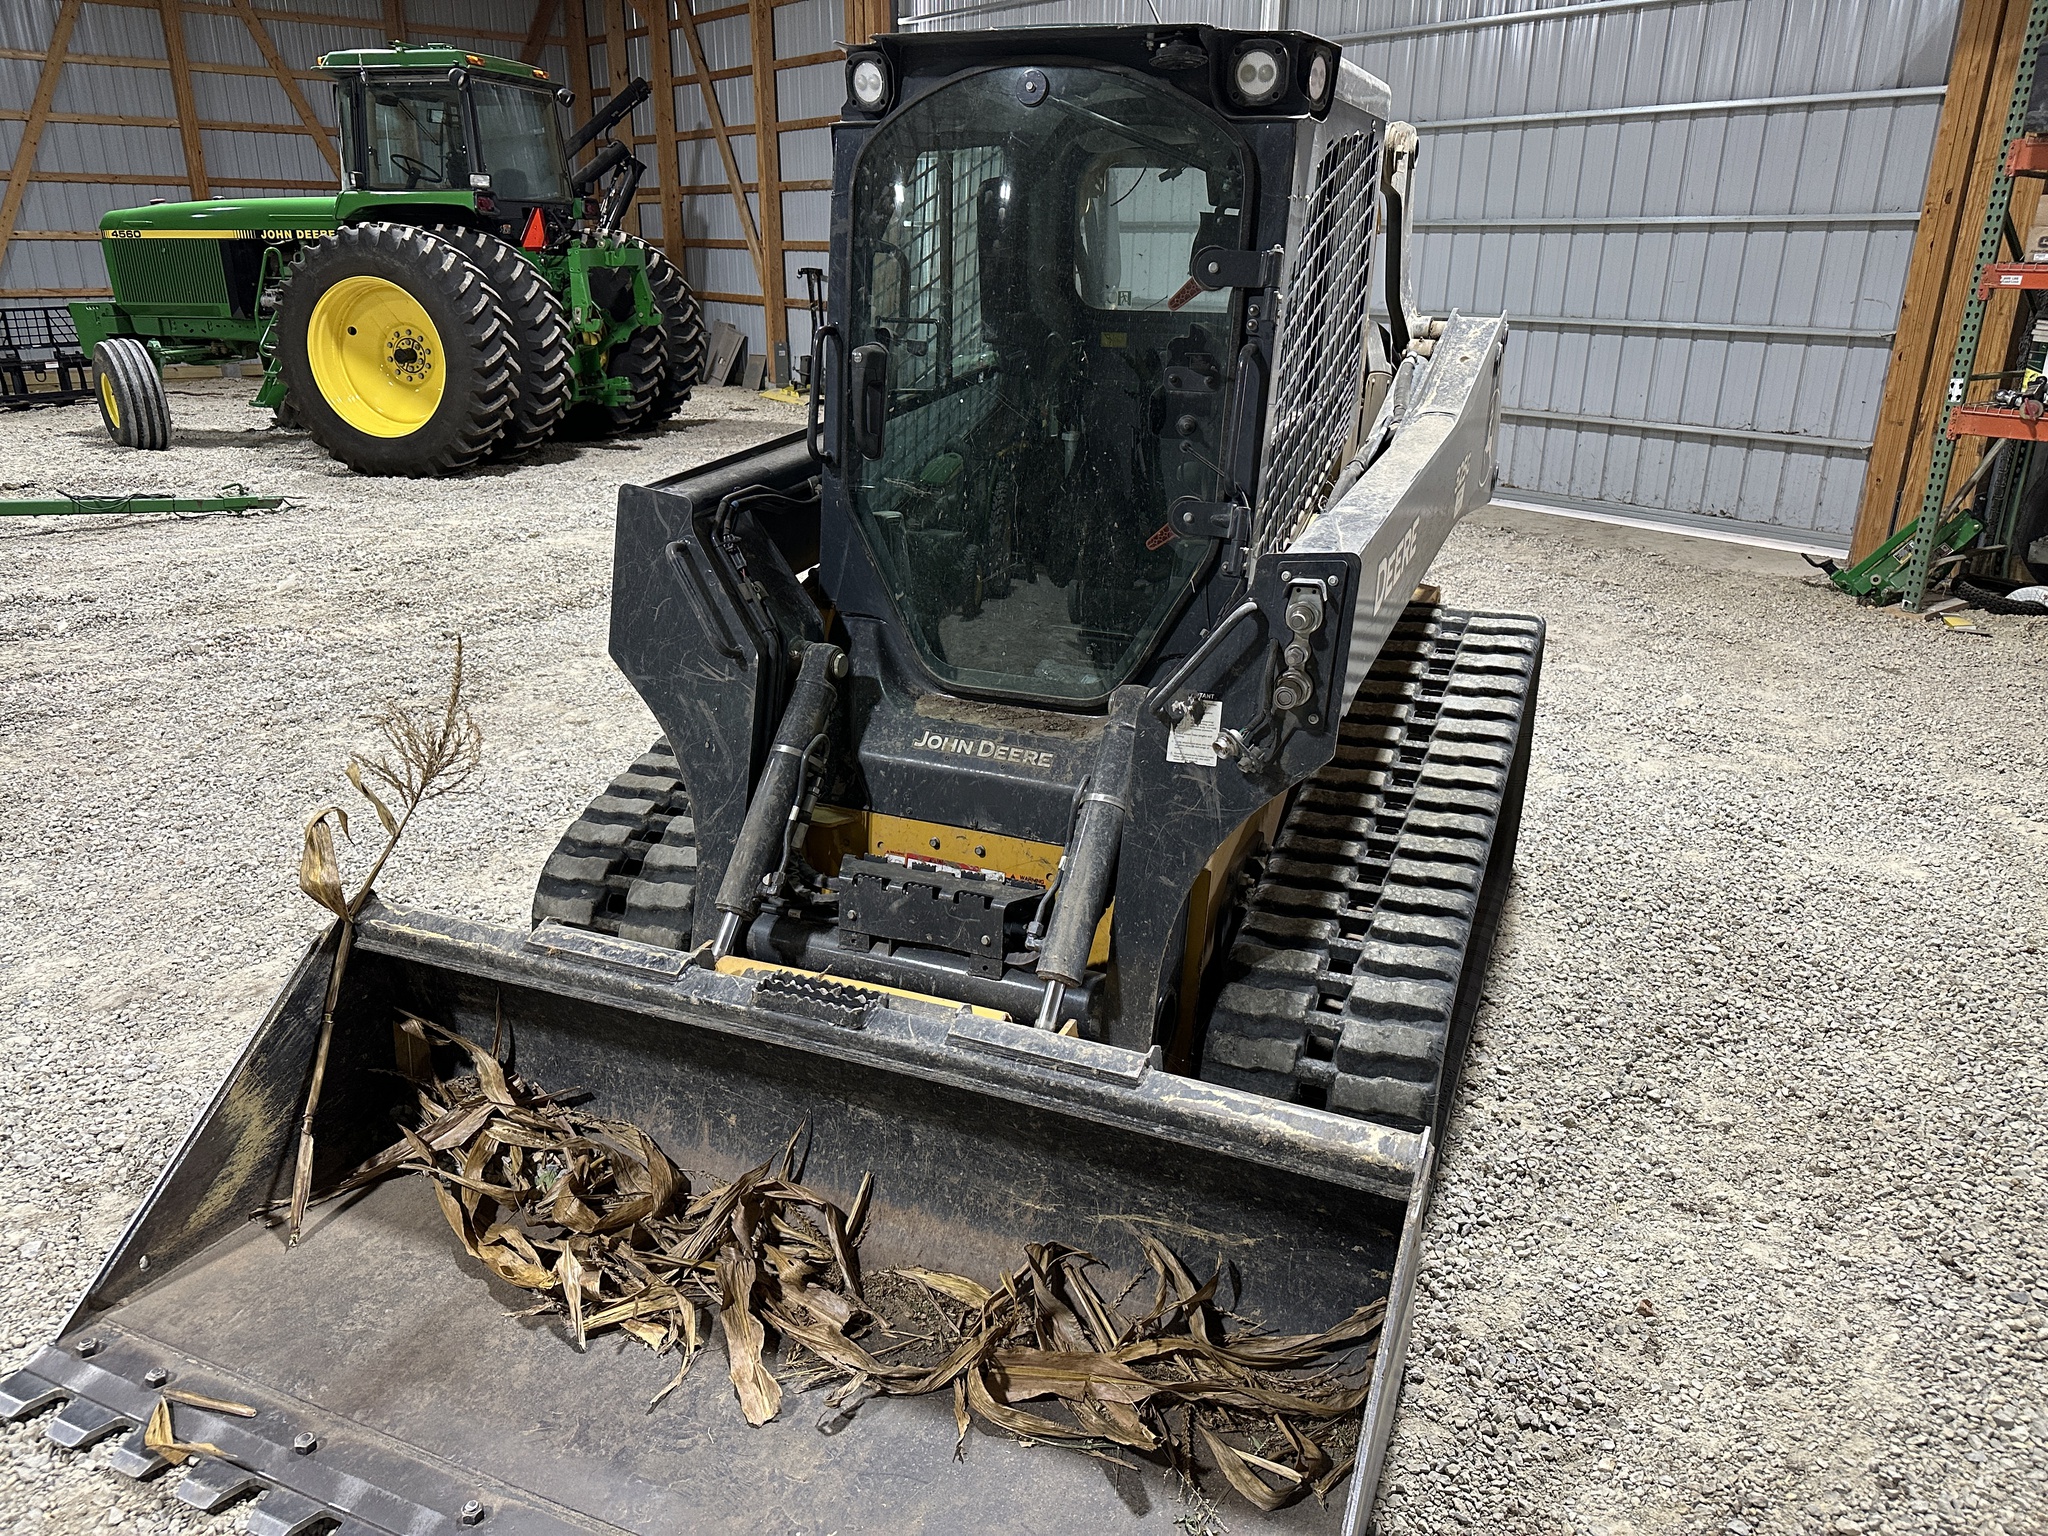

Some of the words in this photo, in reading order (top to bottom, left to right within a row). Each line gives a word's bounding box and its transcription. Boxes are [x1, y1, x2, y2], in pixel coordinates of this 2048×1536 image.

[111, 230, 142, 239] 4560
[260, 229, 293, 239] JOHN
[1373, 515, 1421, 617] DEERE
[913, 731, 974, 755] JOHN
[976, 739, 1054, 768] DEERE
